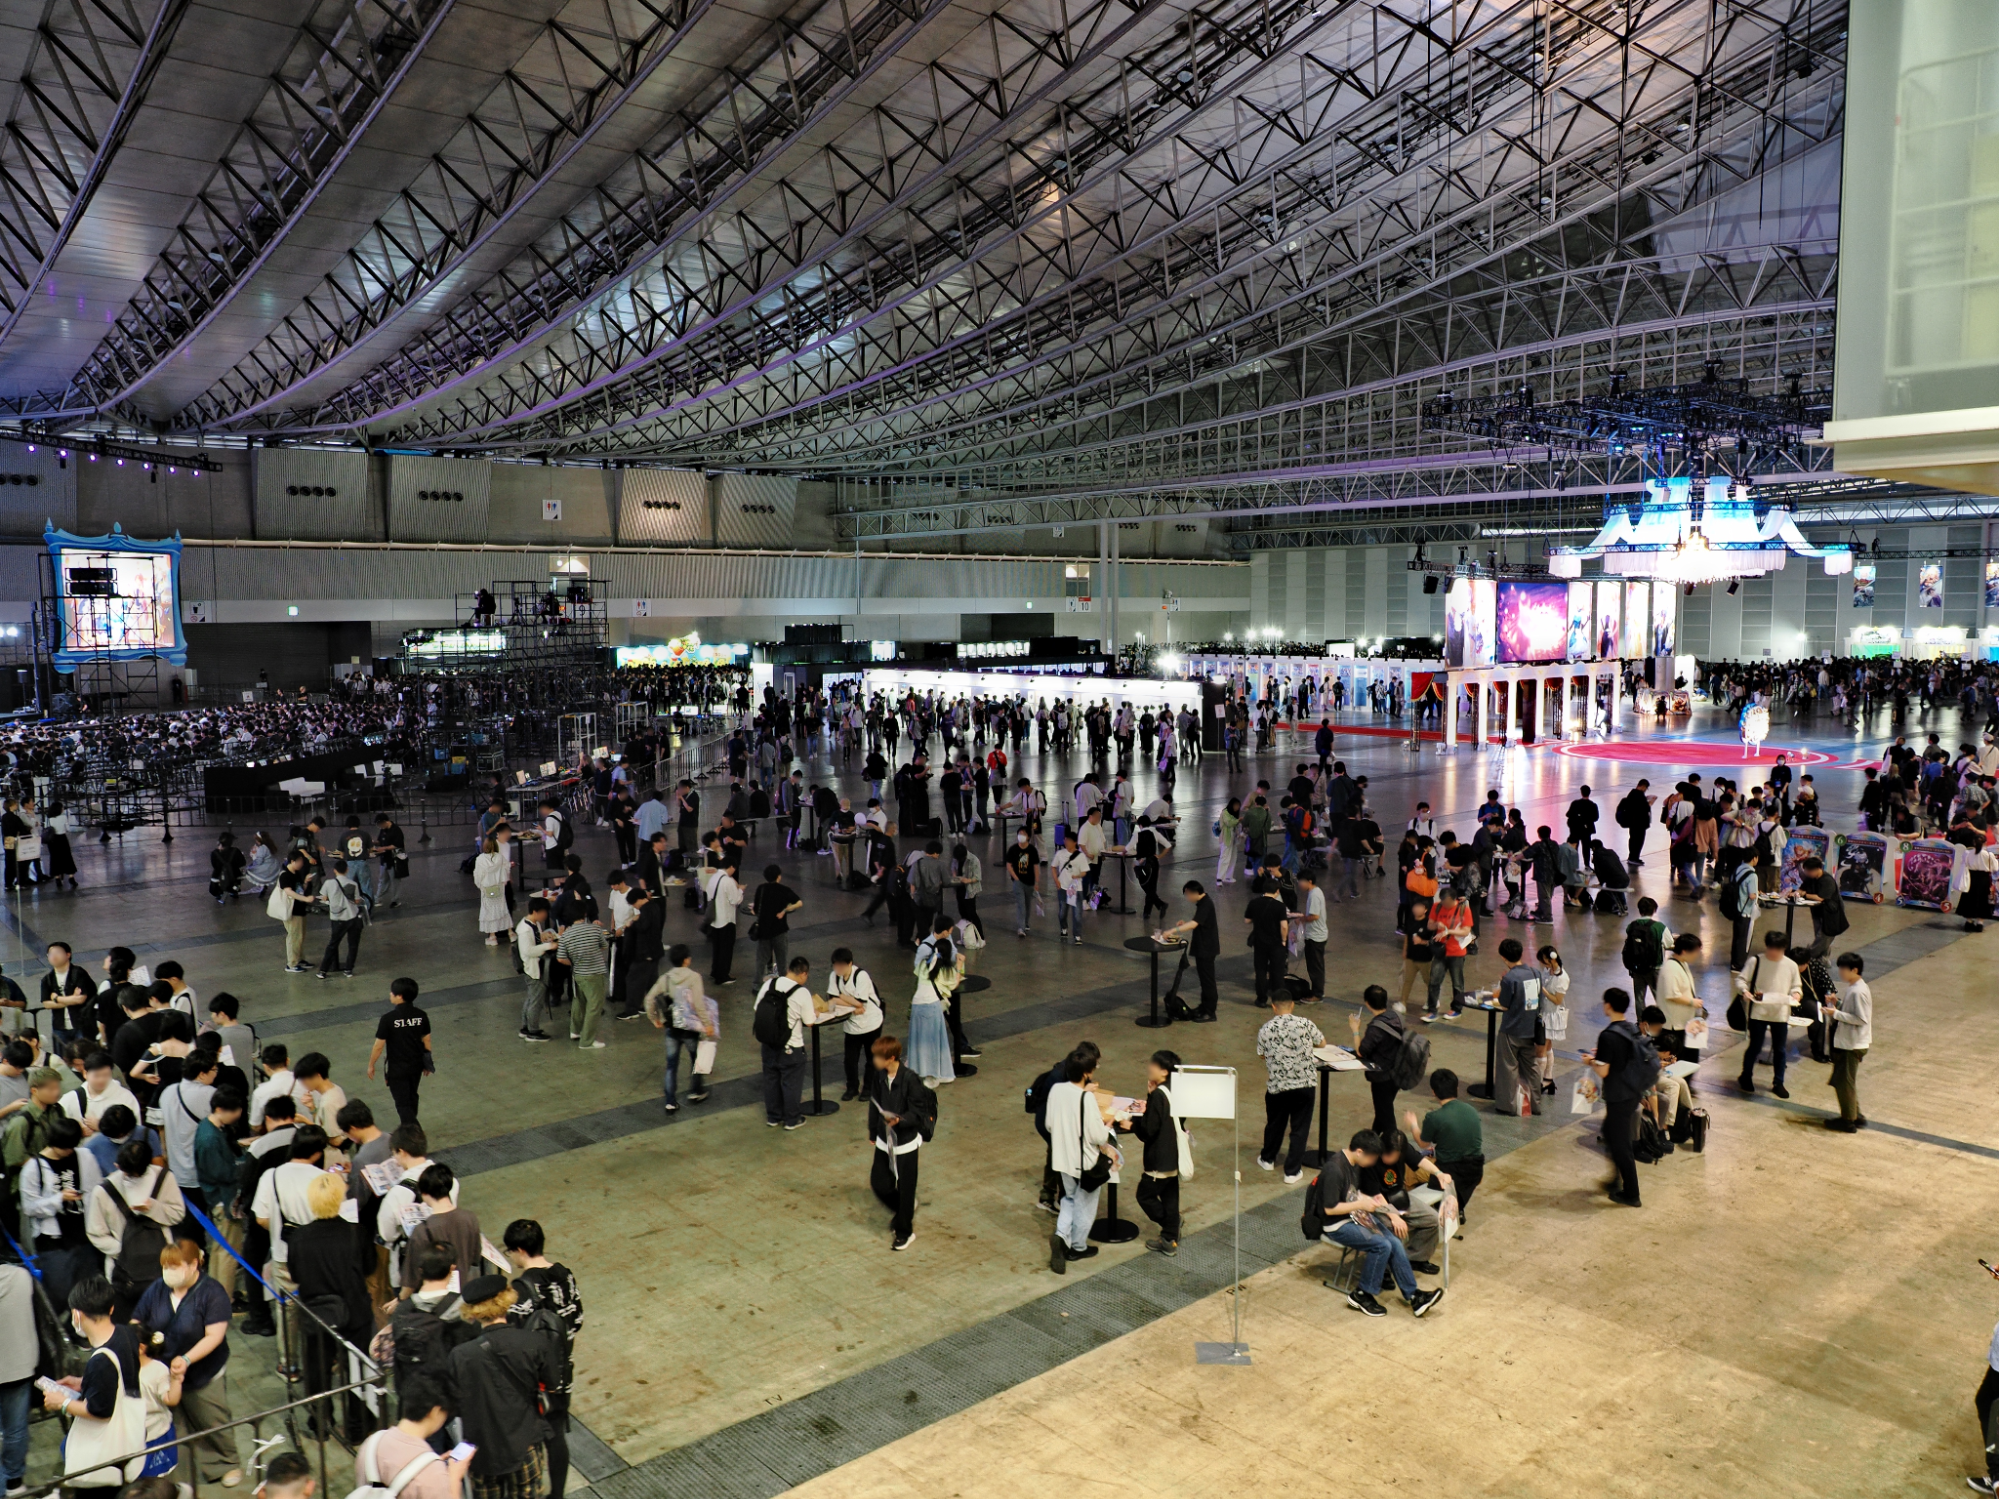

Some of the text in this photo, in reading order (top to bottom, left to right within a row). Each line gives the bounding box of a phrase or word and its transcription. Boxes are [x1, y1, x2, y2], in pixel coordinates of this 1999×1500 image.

[1081, 602, 1089, 611] 10
[1837, 836, 1844, 844] 6
[1902, 842, 1909, 851] 8
[1943, 902, 1950, 911] 5
[393, 1017, 423, 1028] STAFF
